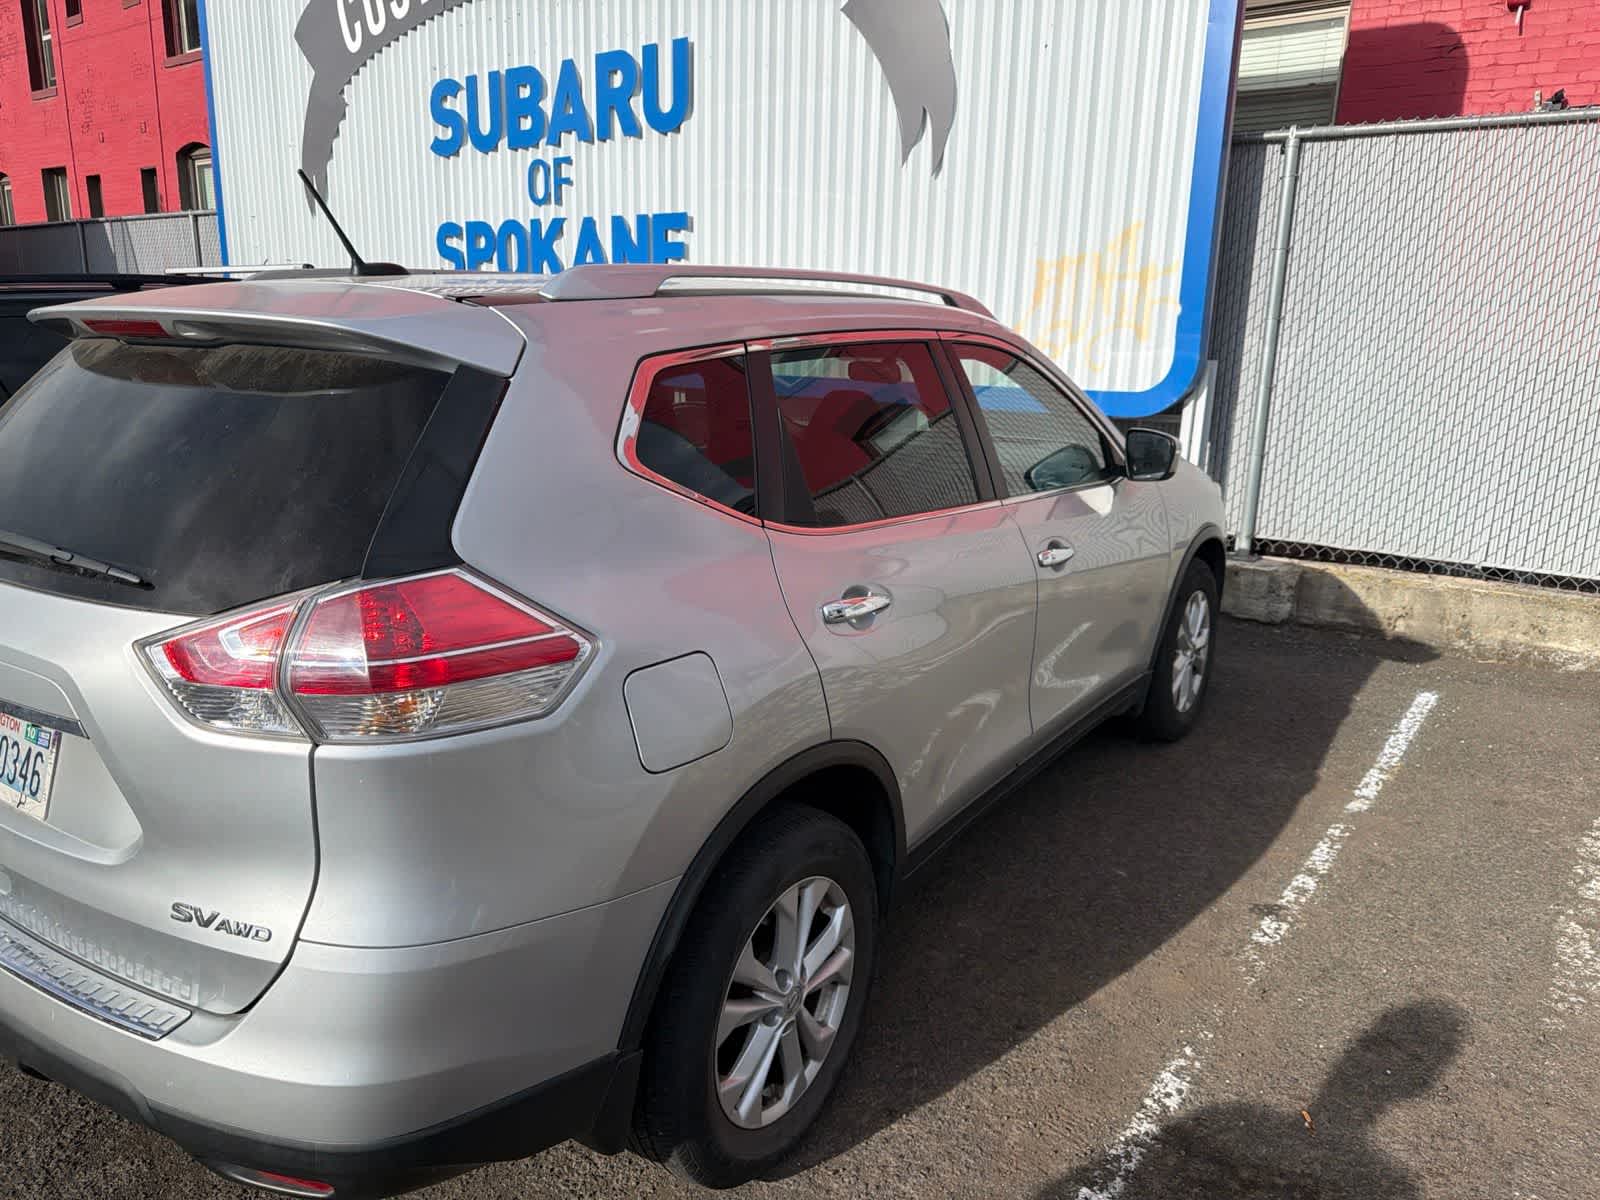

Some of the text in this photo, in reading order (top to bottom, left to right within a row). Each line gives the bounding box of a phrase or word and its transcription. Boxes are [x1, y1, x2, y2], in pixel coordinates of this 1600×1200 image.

[429, 37, 690, 158] SUBARU
[527, 156, 571, 206] OF
[435, 212, 690, 272] SPOKANE
